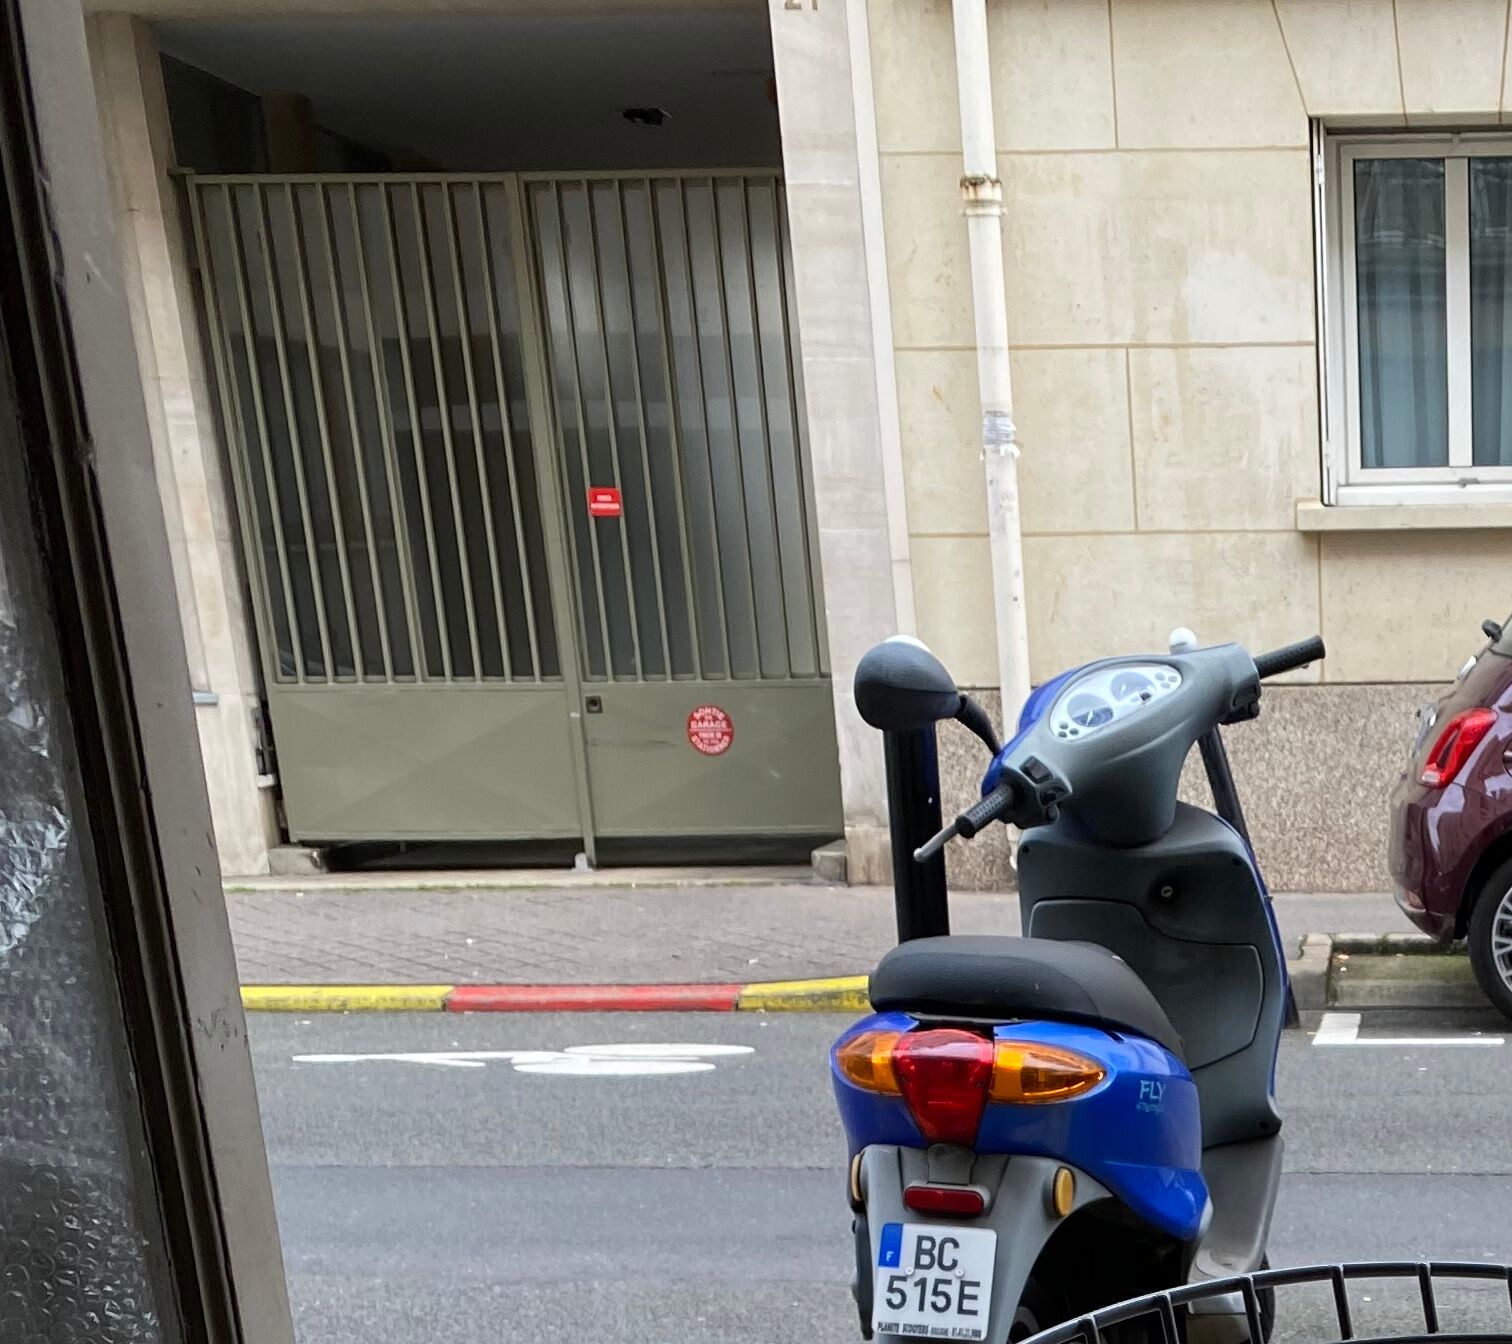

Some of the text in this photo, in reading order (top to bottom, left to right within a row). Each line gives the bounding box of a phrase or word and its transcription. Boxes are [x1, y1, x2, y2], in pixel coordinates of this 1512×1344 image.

[1140, 1079, 1167, 1101] FLY
[886, 1250, 895, 1262] F
[914, 1235, 961, 1272] BC
[885, 1275, 981, 1317] 515E
